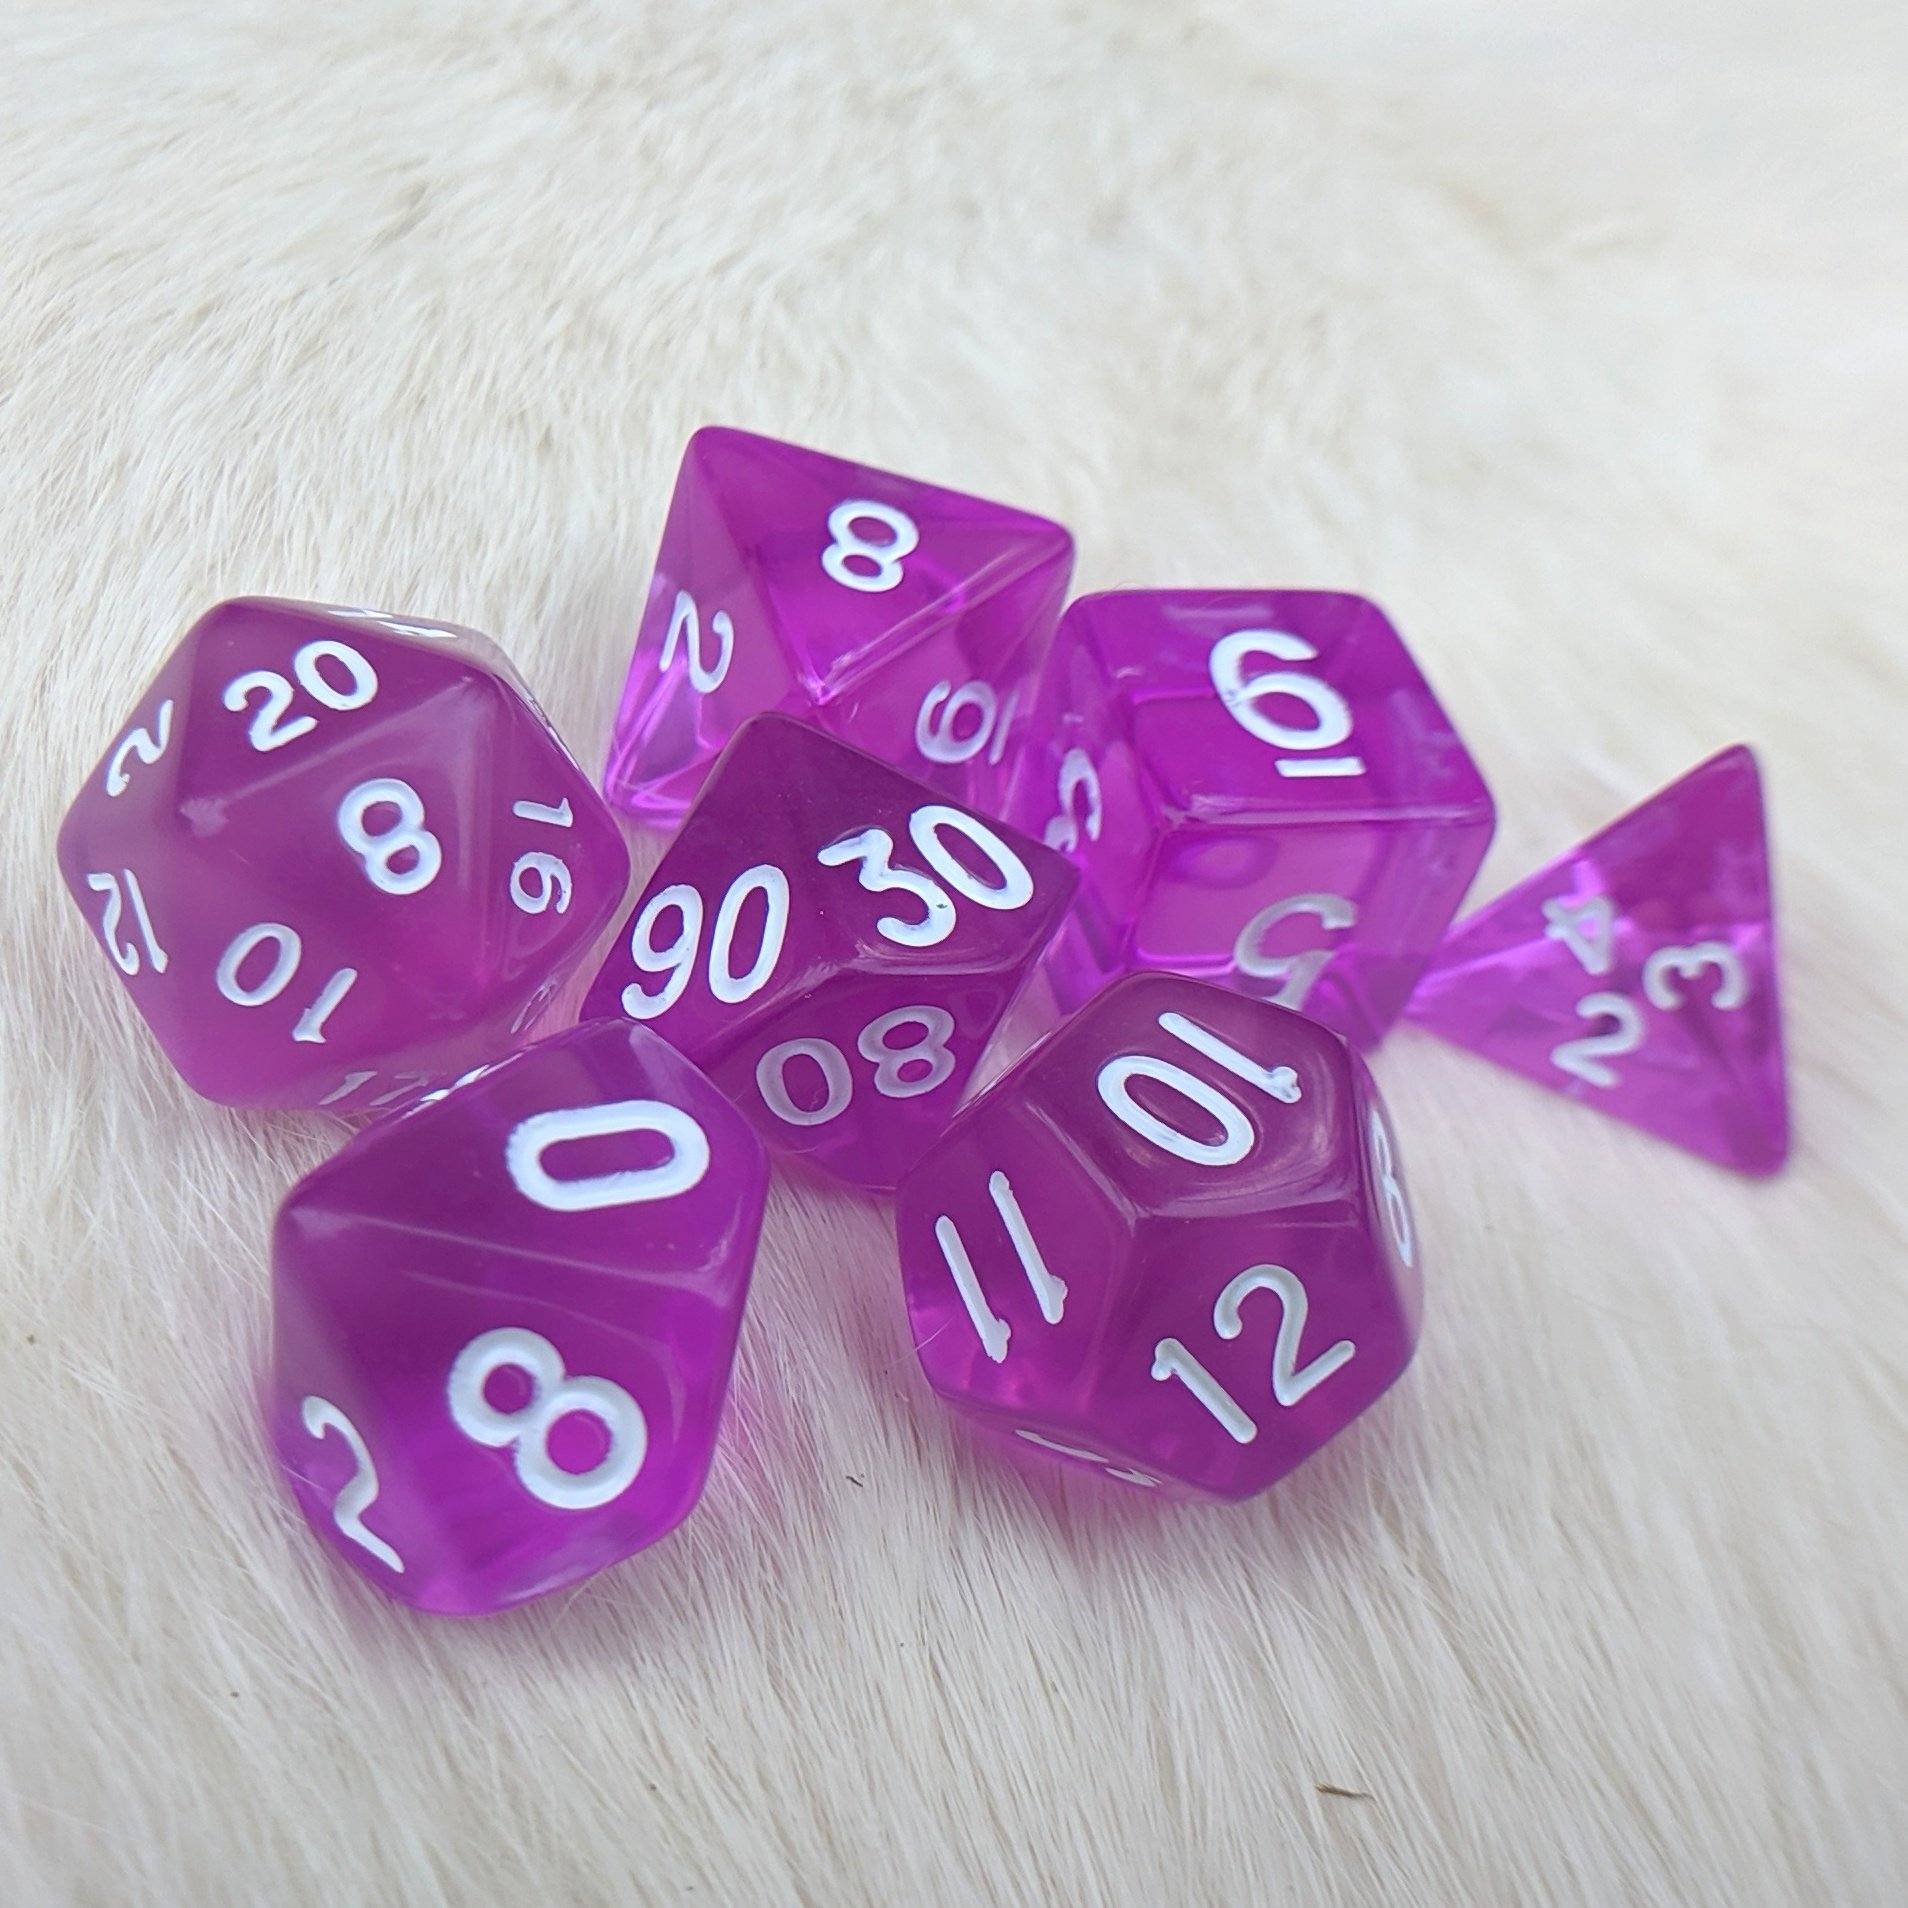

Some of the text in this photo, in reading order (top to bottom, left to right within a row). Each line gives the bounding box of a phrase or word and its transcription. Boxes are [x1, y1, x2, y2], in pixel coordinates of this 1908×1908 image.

[821, 499, 922, 594] 8
[222, 639, 380, 752] 20
[656, 590, 735, 694] 2
[106, 699, 175, 798] 2
[915, 679, 1020, 766] 6
[1208, 629, 1366, 778] 6
[336, 777, 443, 896] 8
[508, 797, 575, 915] 16
[817, 803, 1036, 948] 30
[85, 868, 170, 977] 12
[620, 863, 791, 1021] 90
[1540, 893, 1614, 976] 4
[1640, 940, 1745, 1012] 3
[215, 922, 359, 1045] 10
[1550, 991, 1642, 1086] 2
[755, 1005, 957, 1127] 80
[1097, 1011, 1303, 1167] 10
[504, 1098, 710, 1213] 0
[934, 1170, 1069, 1364] 11
[1150, 1263, 1356, 1444] 12
[446, 1326, 648, 1510] 8
[303, 1395, 405, 1573] 2
